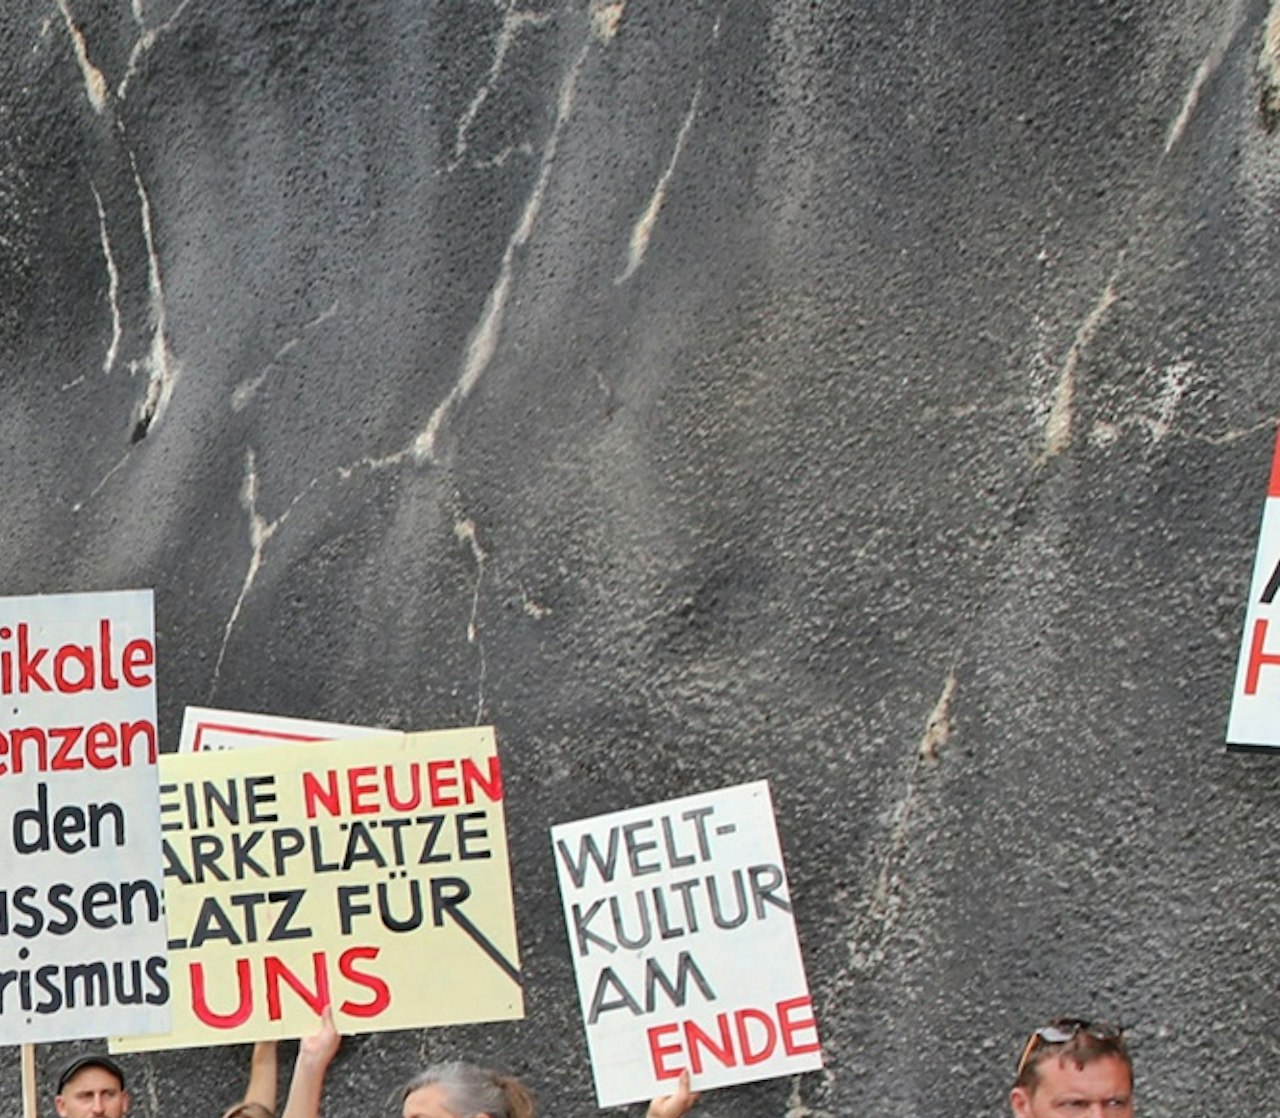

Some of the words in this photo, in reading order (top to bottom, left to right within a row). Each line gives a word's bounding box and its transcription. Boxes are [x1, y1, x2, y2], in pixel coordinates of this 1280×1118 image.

[13, 783, 125, 854] den
[159, 775, 278, 831] EINE
[303, 756, 503, 818] NEUEN
[162, 811, 492, 885] ARKPLÄTZE
[556, 806, 737, 889] WELT-
[337, 872, 522, 987] FÜR
[571, 864, 792, 957] KULTUR
[189, 946, 391, 1029] UNS
[587, 950, 716, 1025] AM
[646, 995, 821, 1081] ENDE
